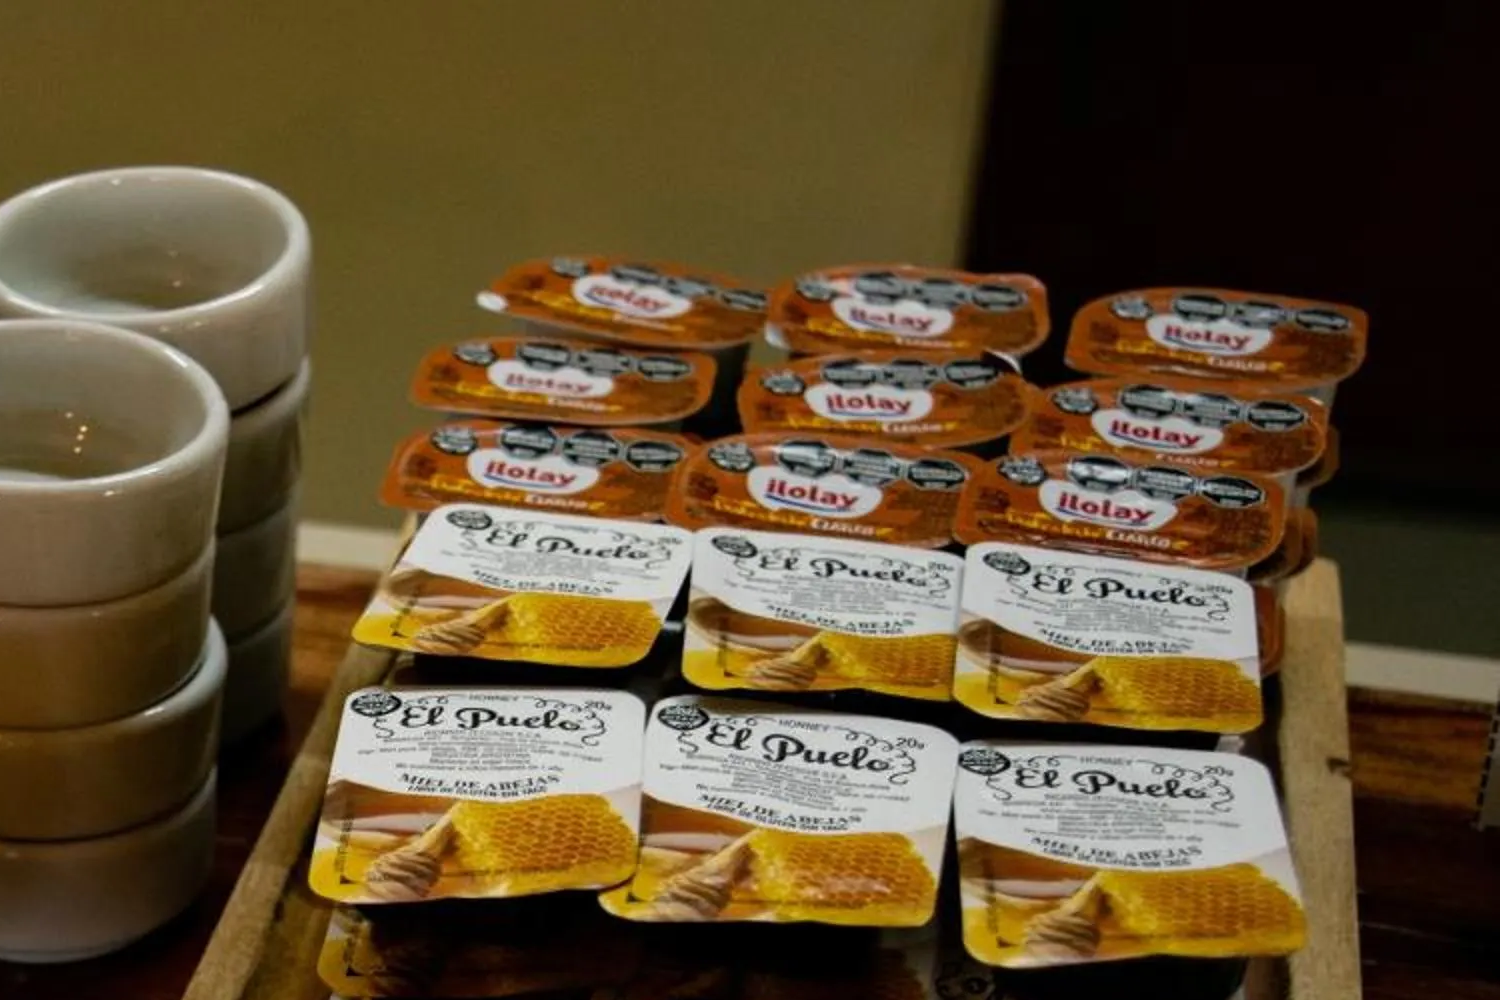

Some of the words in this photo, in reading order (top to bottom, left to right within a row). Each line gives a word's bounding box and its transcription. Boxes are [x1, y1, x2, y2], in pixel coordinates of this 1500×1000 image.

[1032, 572, 1073, 596] El
[1083, 577, 1207, 607] Puelo
[400, 705, 445, 729] El
[455, 707, 582, 731] Puelo
[705, 723, 752, 751] El
[761, 733, 891, 772] Puelo
[1015, 768, 1062, 788] El
[1072, 770, 1208, 799] Puelo
